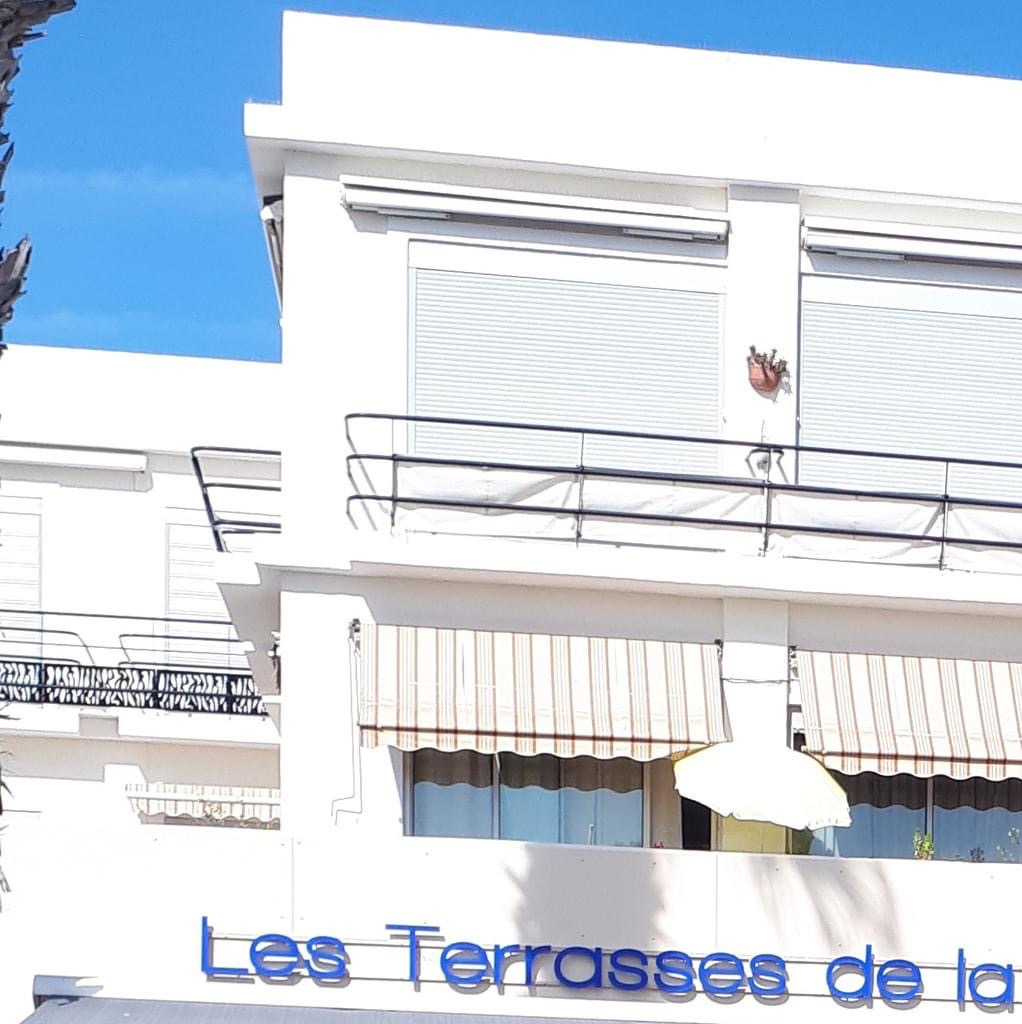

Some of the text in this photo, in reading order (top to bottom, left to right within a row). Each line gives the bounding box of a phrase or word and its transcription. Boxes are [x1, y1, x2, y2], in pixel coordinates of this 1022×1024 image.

[201, 916, 348, 980] Les
[385, 923, 787, 996] Terrasses
[825, 944, 923, 1002] de
[956, 948, 1014, 1005] la
